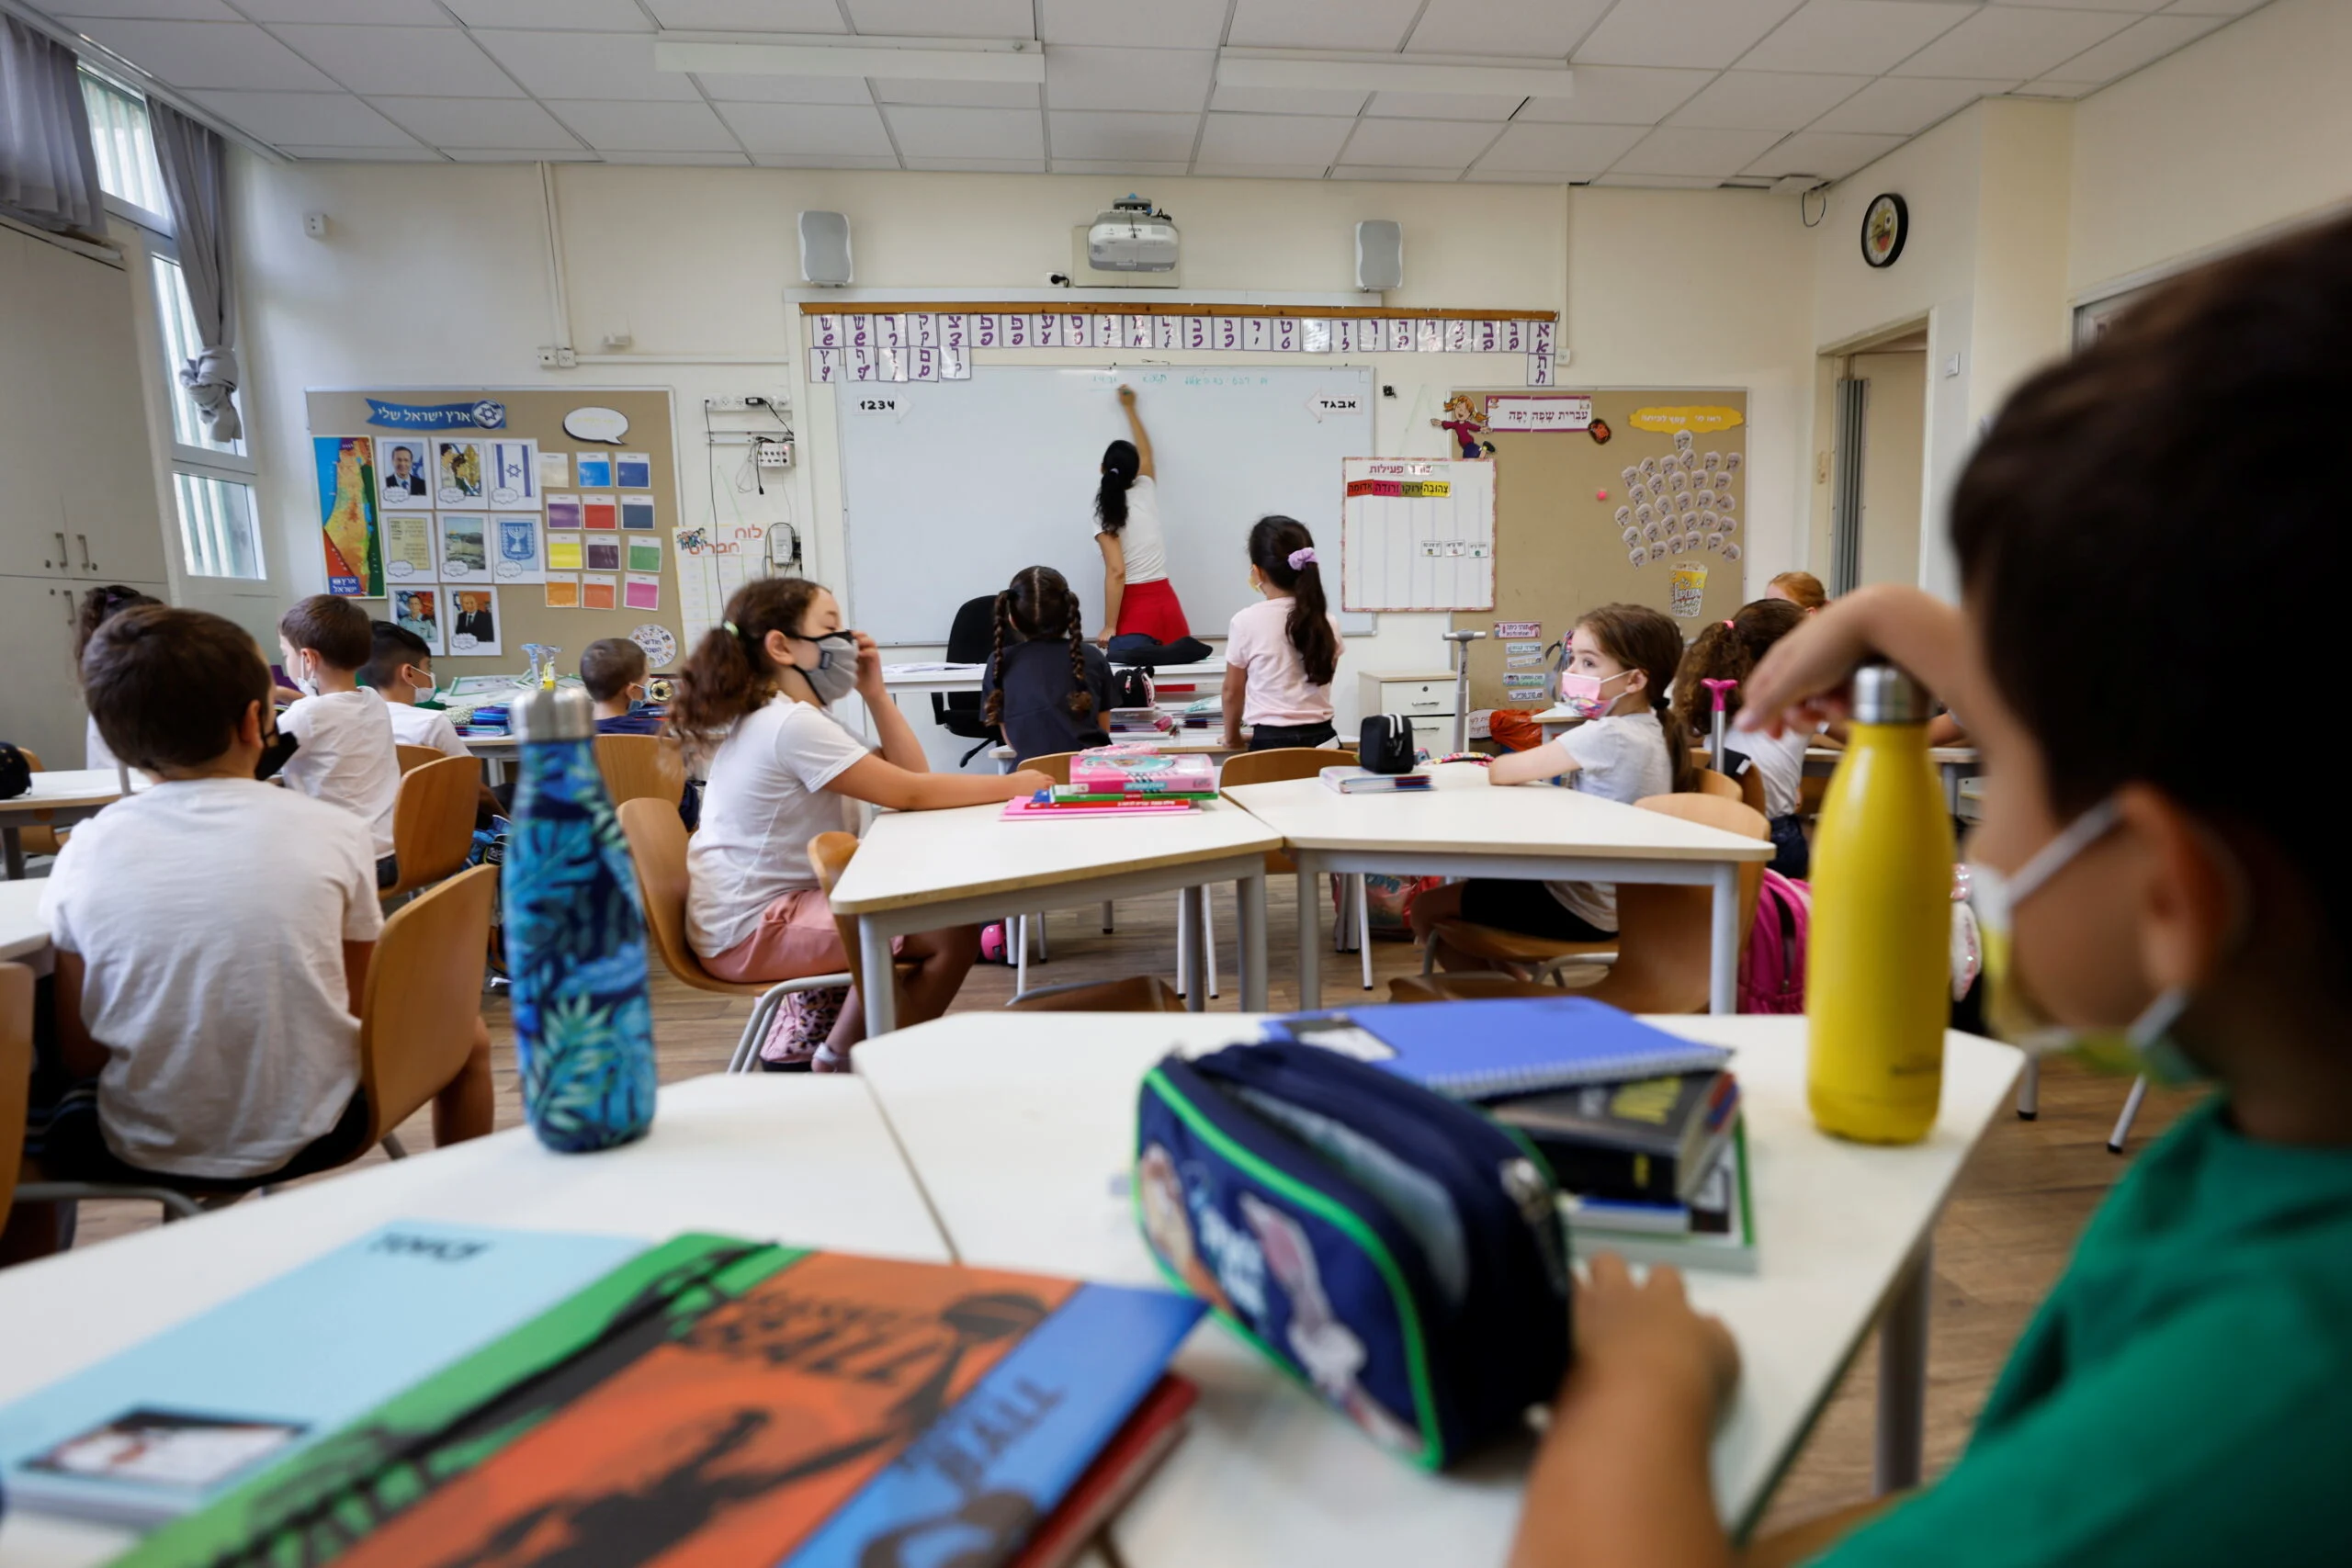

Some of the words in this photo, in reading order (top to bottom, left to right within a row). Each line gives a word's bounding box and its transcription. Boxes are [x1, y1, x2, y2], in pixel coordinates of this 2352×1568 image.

[919, 314, 929, 330] ק
[948, 316, 962, 329] צ
[1042, 315, 1055, 329] ע
[1280, 320, 1293, 333] ט
[1537, 323, 1550, 338] א
[860, 400, 895, 410] 1234
[1320, 400, 1356, 409] אבגד
[378, 406, 401, 421] שלי
[404, 409, 442, 422] ישראל
[446, 411, 471, 423] ארץ
[1369, 463, 1404, 474] פעילות
[735, 524, 763, 539] לוח
[688, 542, 741, 555] חברים
